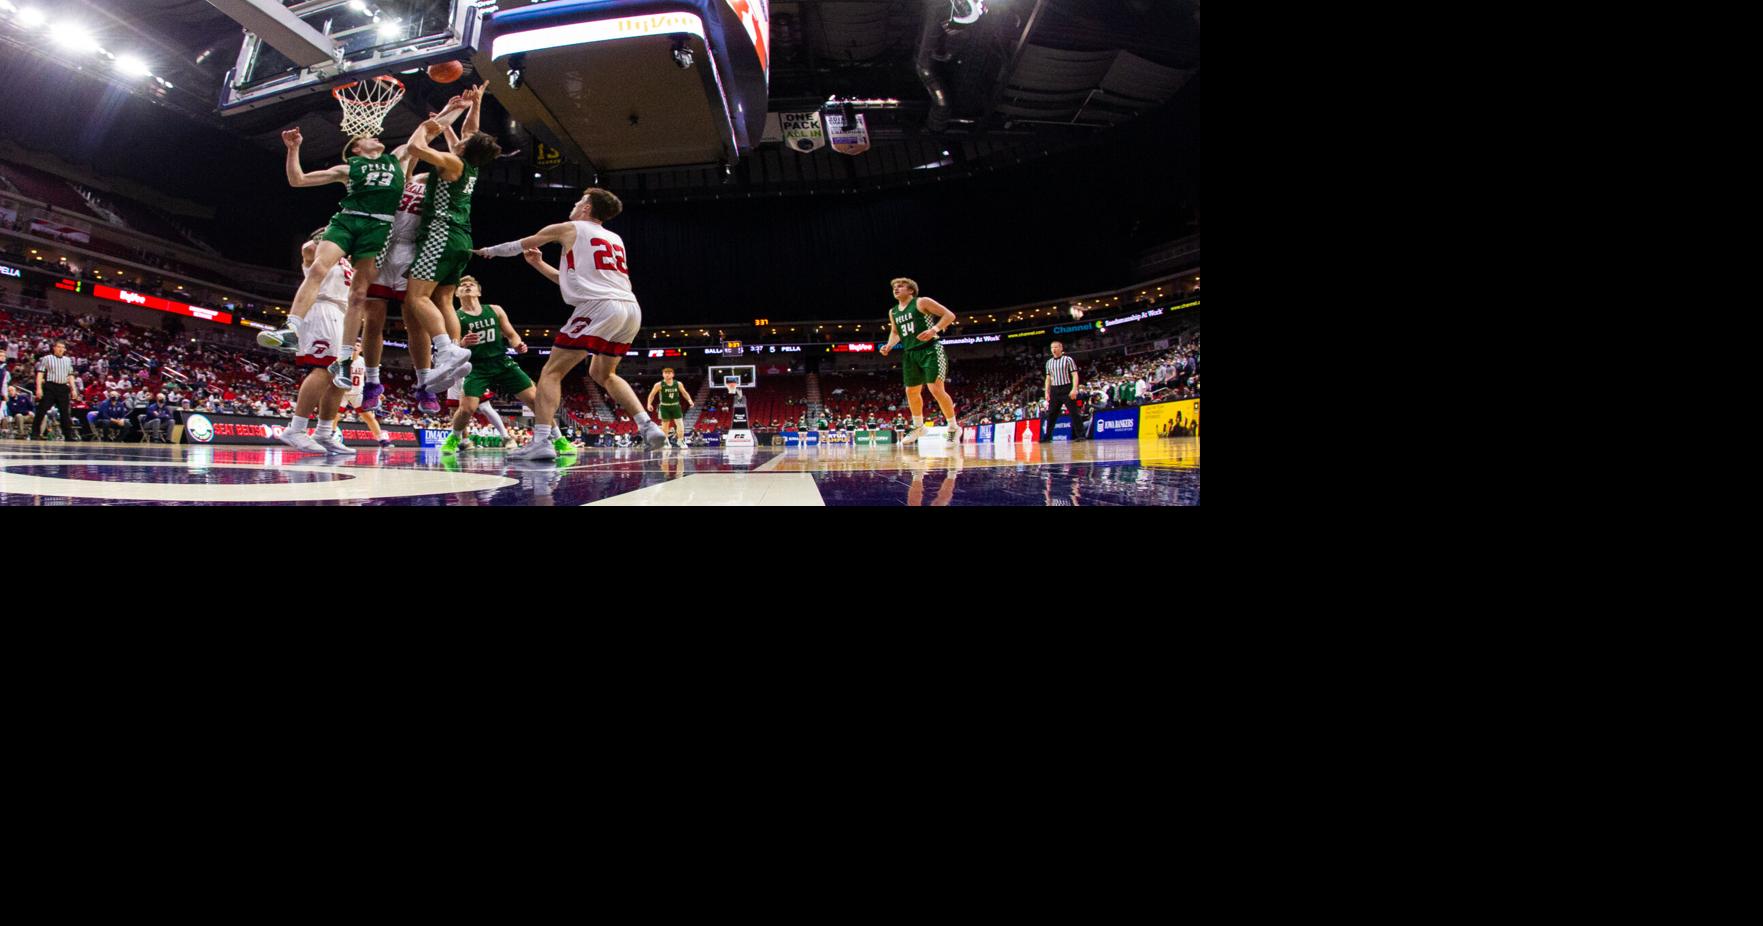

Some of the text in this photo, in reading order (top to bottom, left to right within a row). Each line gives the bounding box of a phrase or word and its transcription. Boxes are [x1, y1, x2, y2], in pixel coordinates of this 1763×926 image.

[786, 113, 813, 122] ONE
[784, 121, 820, 129] PACK
[787, 130, 808, 138] ALL
[361, 162, 395, 174] PELLA
[364, 171, 394, 187] 23
[468, 317, 496, 331] PELLA
[895, 312, 913, 325] PELLA
[901, 322, 915, 337] 34
[1053, 322, 1092, 334] Channel
[477, 328, 496, 345] 20
[213, 423, 234, 435] SEAT
[425, 430, 448, 440] DMACC
